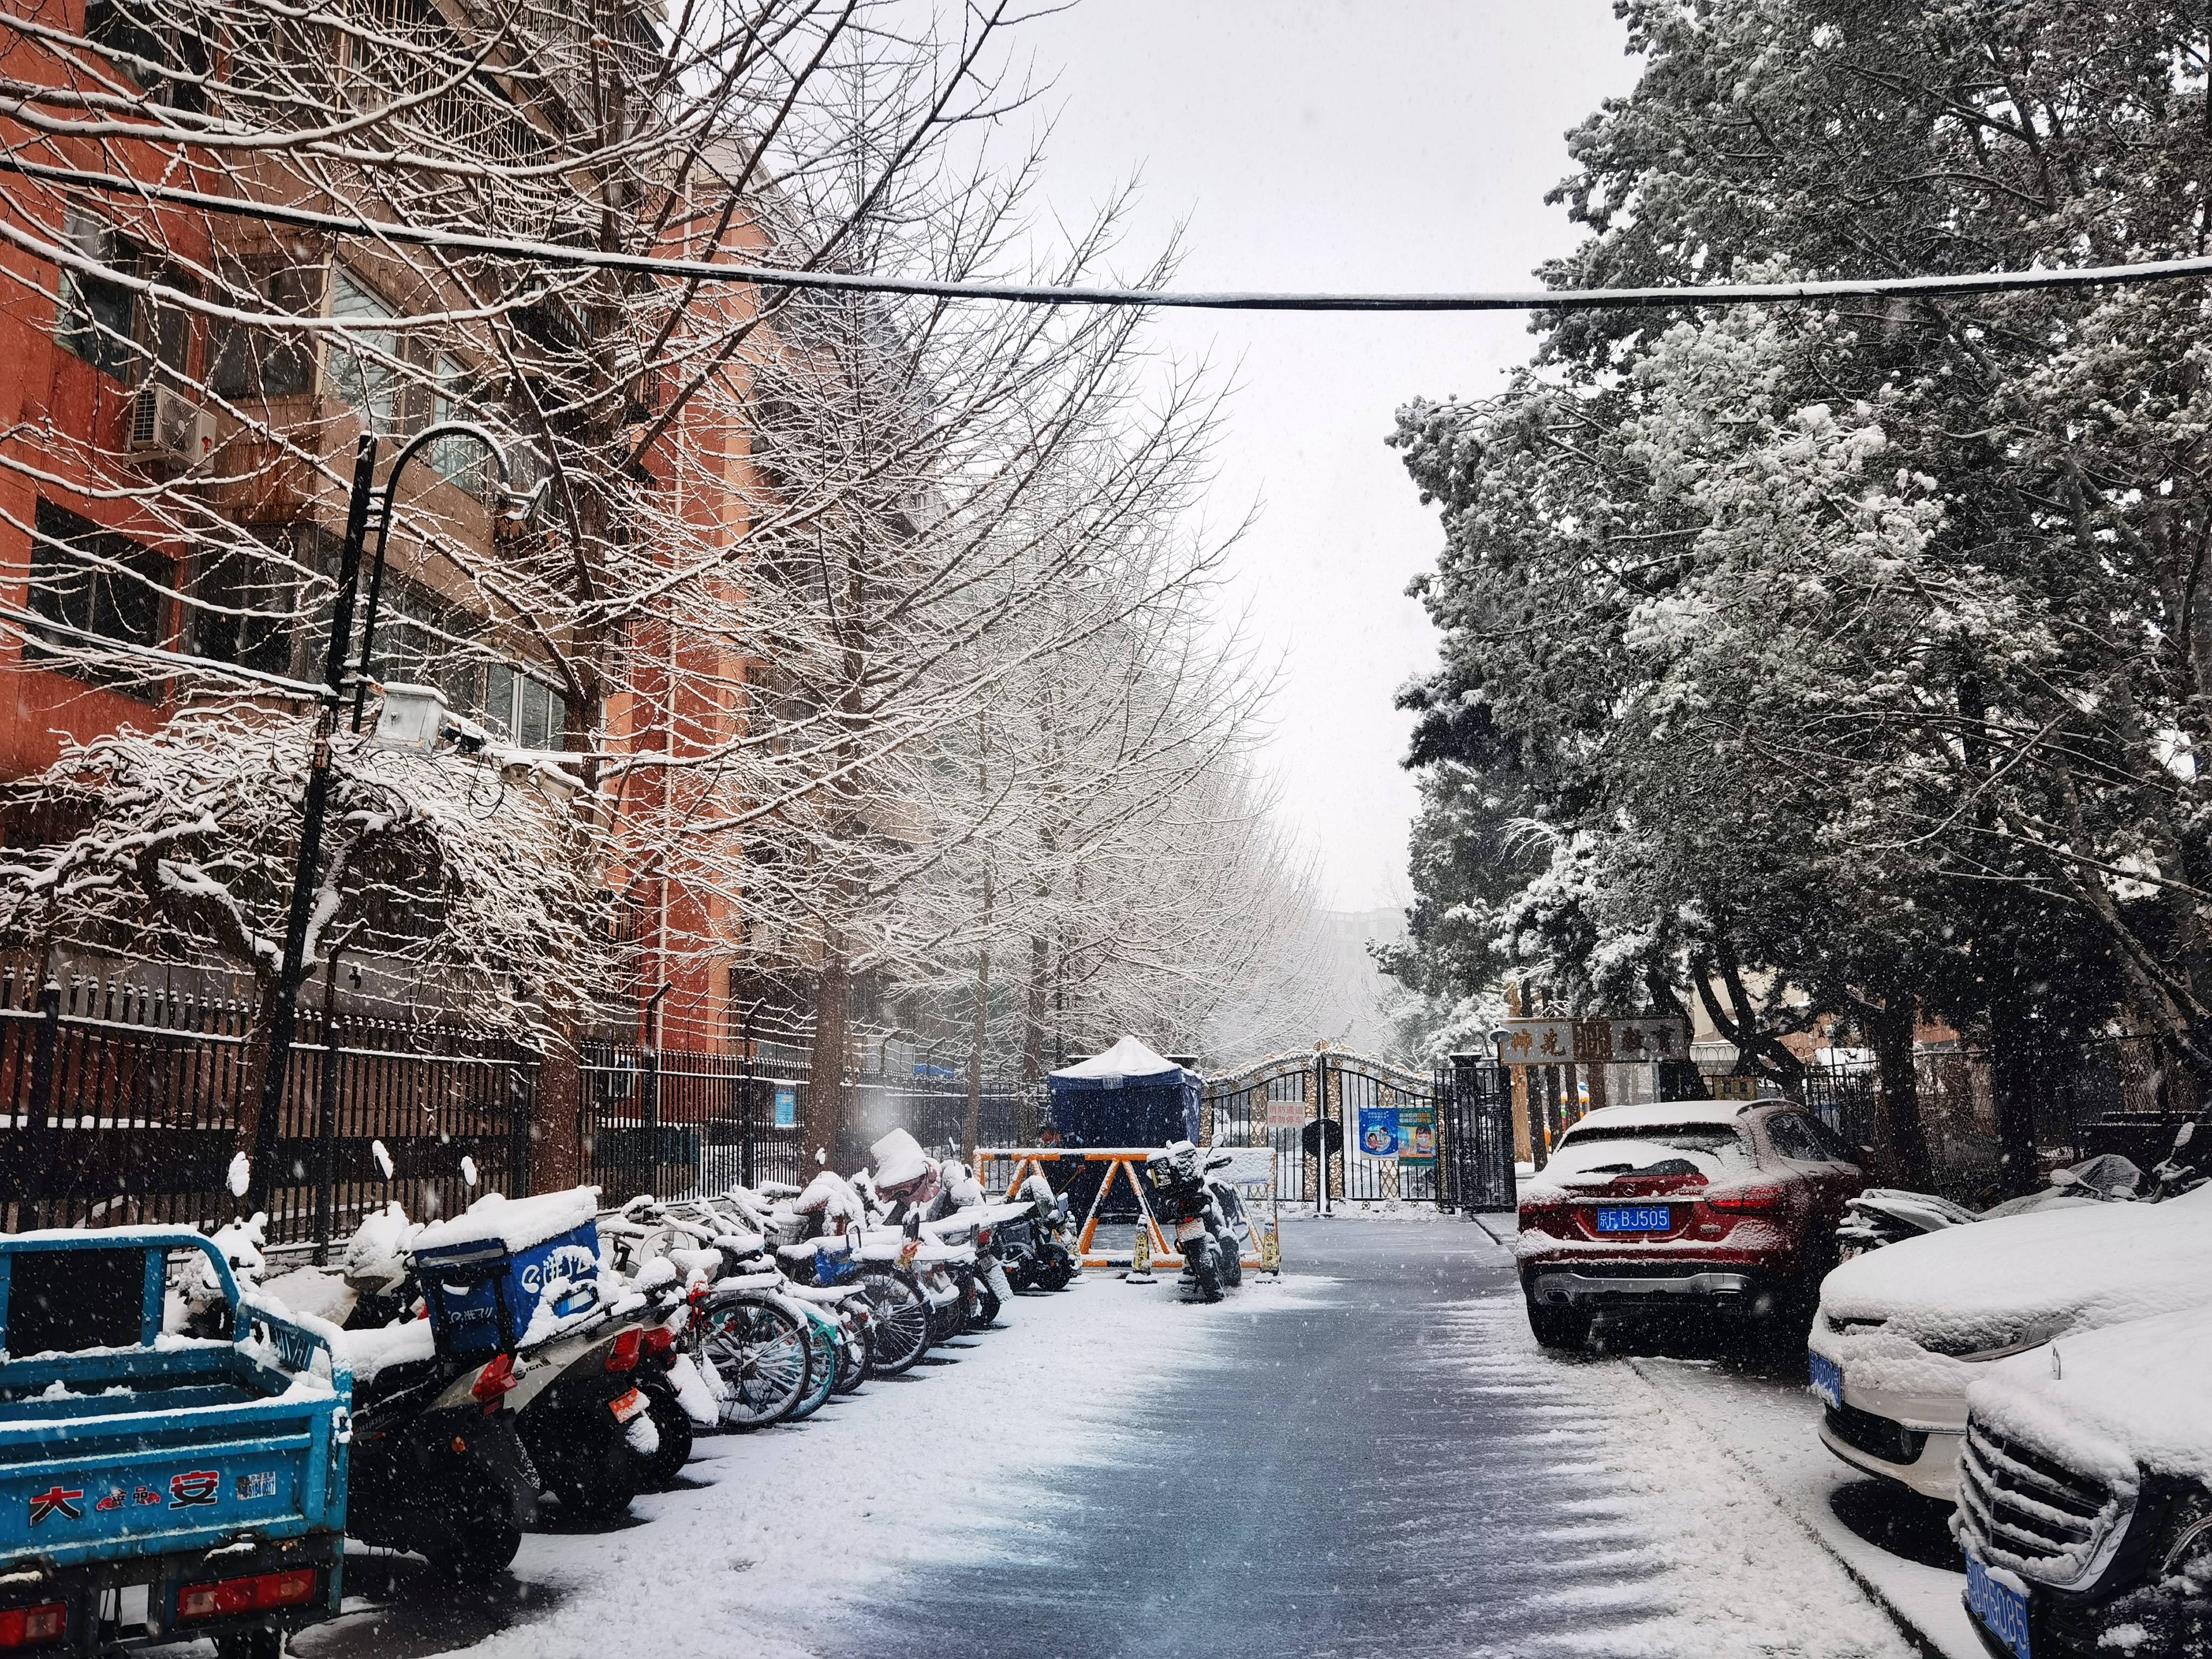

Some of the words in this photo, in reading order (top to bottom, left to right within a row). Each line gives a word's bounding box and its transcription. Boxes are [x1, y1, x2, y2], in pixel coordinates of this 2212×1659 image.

[1269, 1105, 1303, 1114] 消防通道
[1269, 1116, 1303, 1124] 请勿停车
[30, 1486, 84, 1529] 大
[168, 1469, 219, 1510] 安
